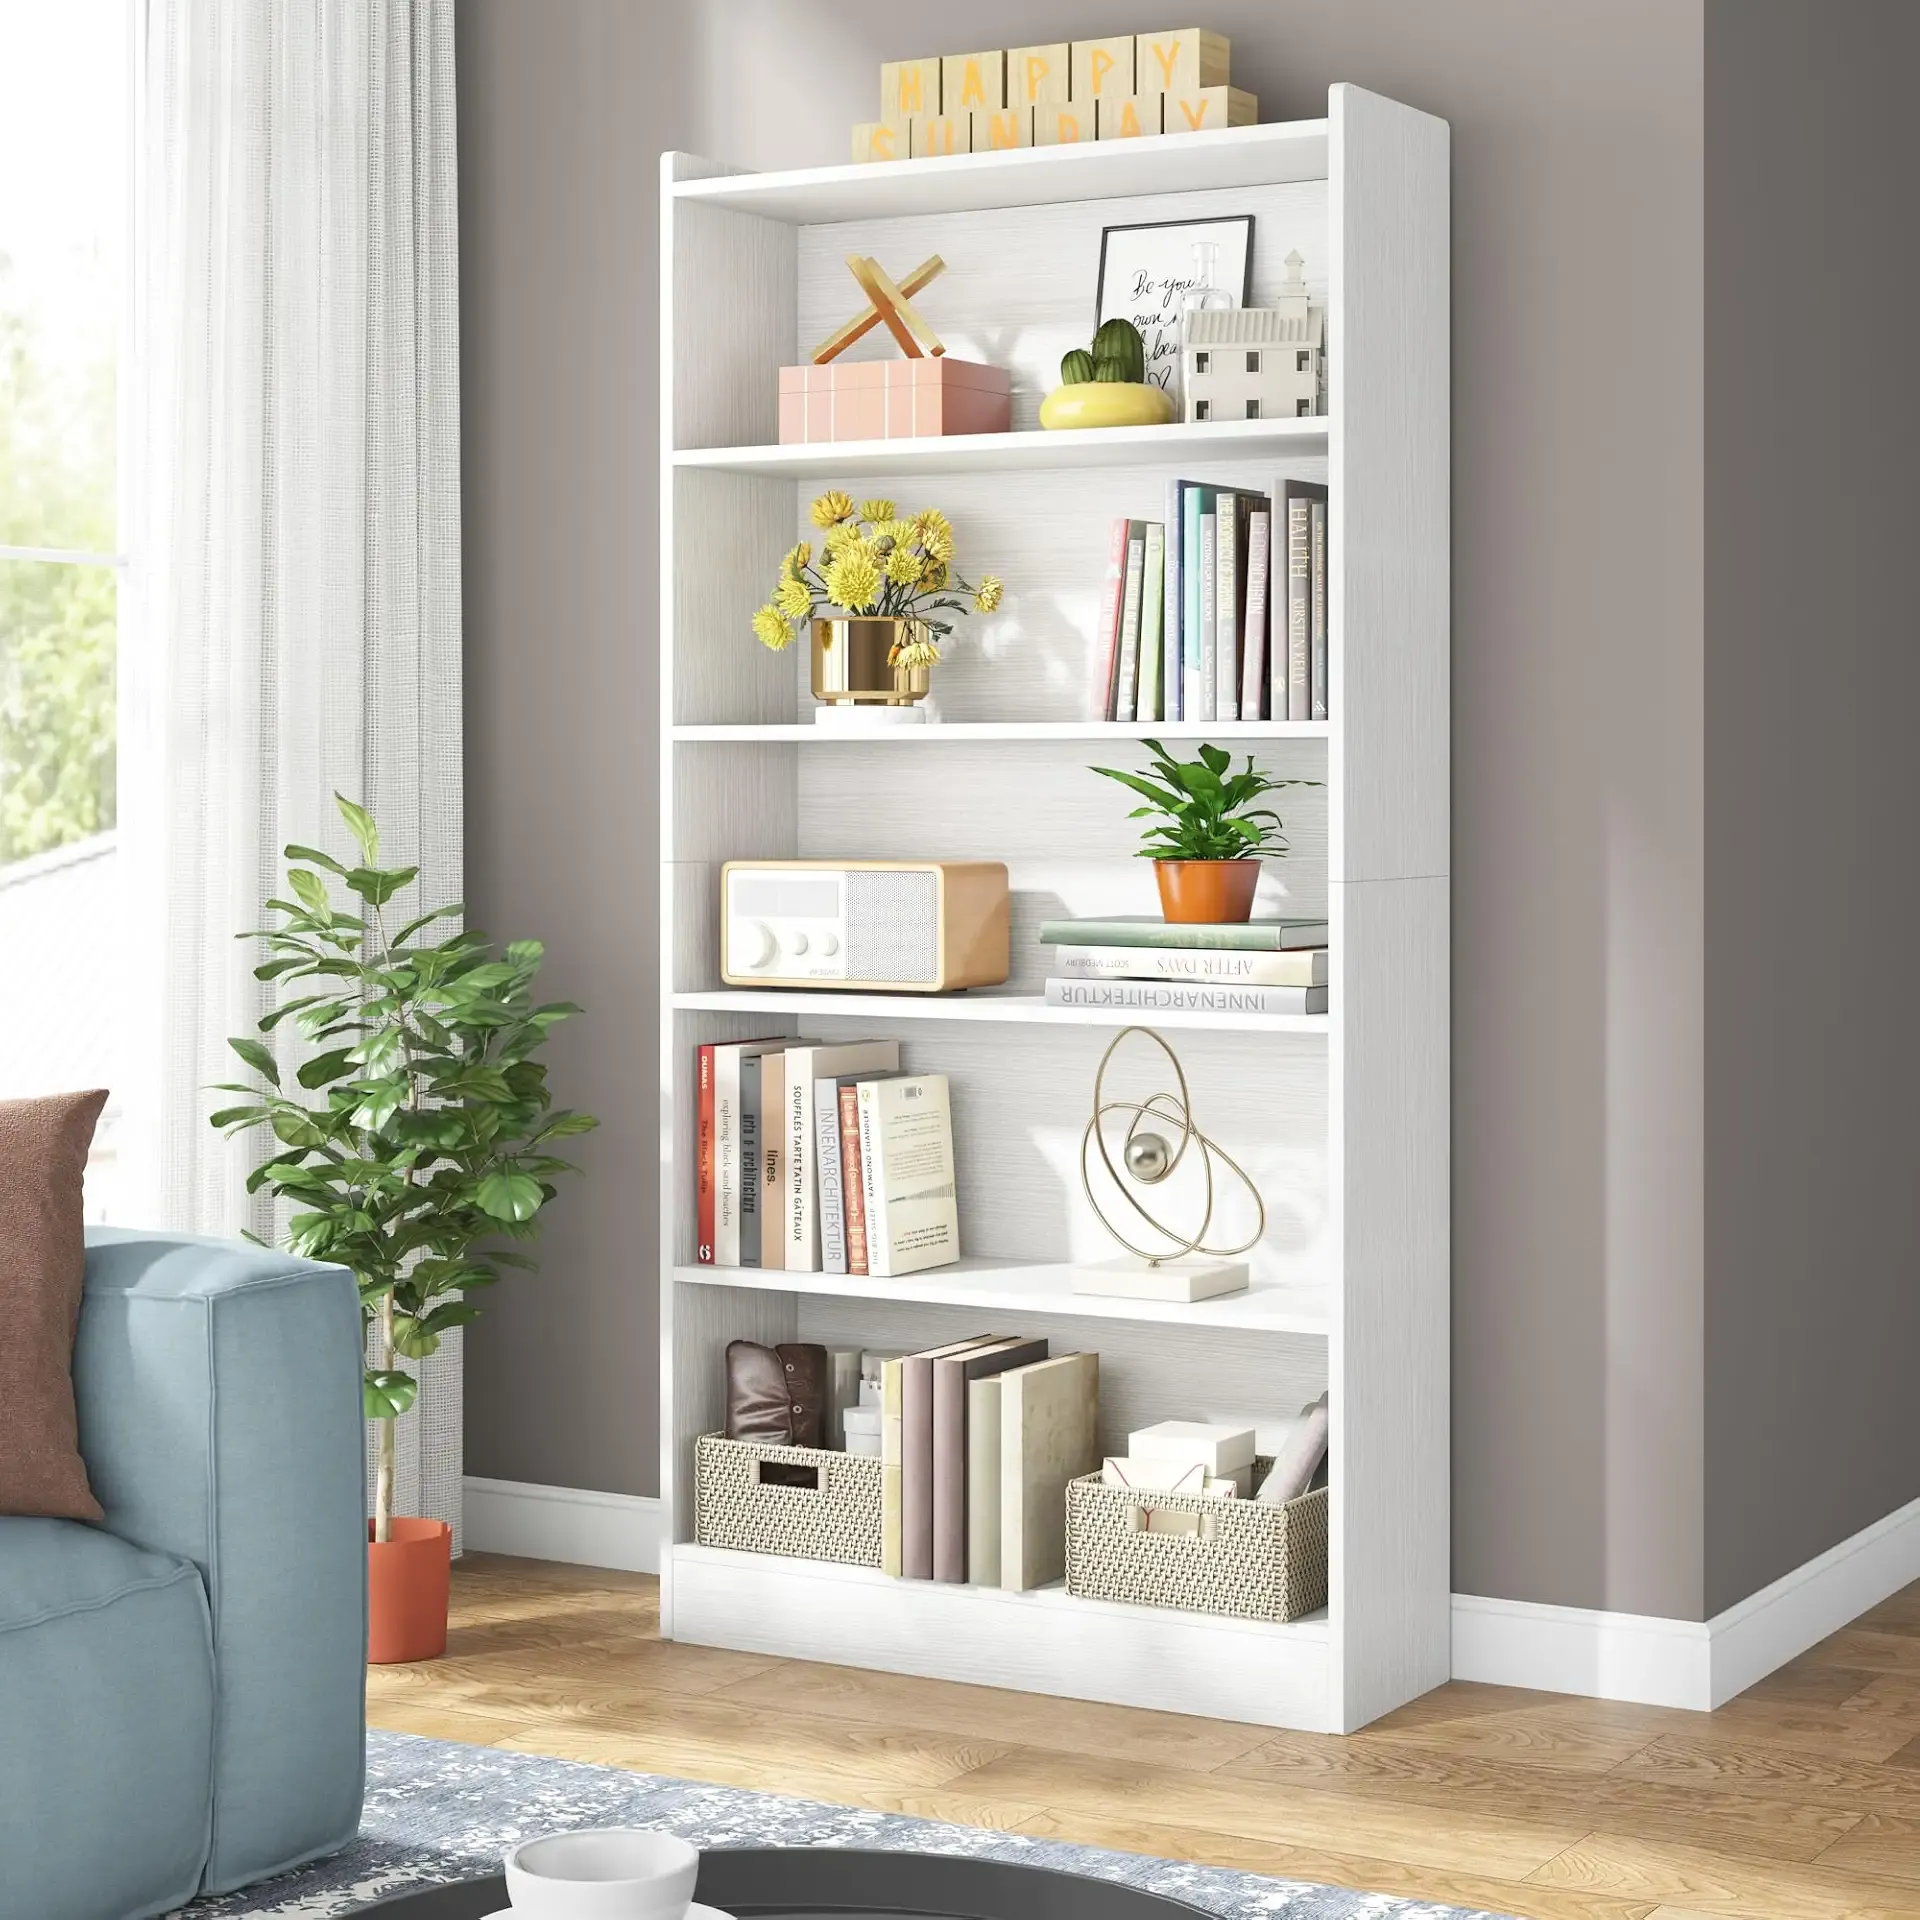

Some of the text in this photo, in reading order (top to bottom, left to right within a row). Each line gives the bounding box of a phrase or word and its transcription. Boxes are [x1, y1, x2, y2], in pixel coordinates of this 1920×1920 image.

[901, 39, 1181, 112] HAPPY
[871, 98, 1209, 161] SUNDAY
[1130, 269, 1154, 302] Be
[1219, 497, 1234, 515] THE
[1219, 515, 1234, 560] PROPHECY
[1219, 561, 1234, 575] OF
[1291, 597, 1306, 687] KIRSTEN KELLY
[1064, 958, 1130, 969] SCOTT MEDBURY
[1156, 959, 1254, 976] AFTER DAYS
[1061, 985, 1266, 1011] INNENARCHITEKTUR
[700, 1119, 708, 1194] The Black Tulip
[720, 1099, 732, 1227] exploring black sand beaches
[766, 1149, 779, 1187] lines.
[794, 1085, 805, 1242] SOUFFLÉS TARTE TATIN GÂTEAUX
[862, 1109, 875, 1198] RAYMOND CHANDLER
[742, 1151, 757, 1213] architecture
[819, 1107, 842, 1261] INNENARCHITEKTUR
[869, 1208, 877, 1230] SLEEP
